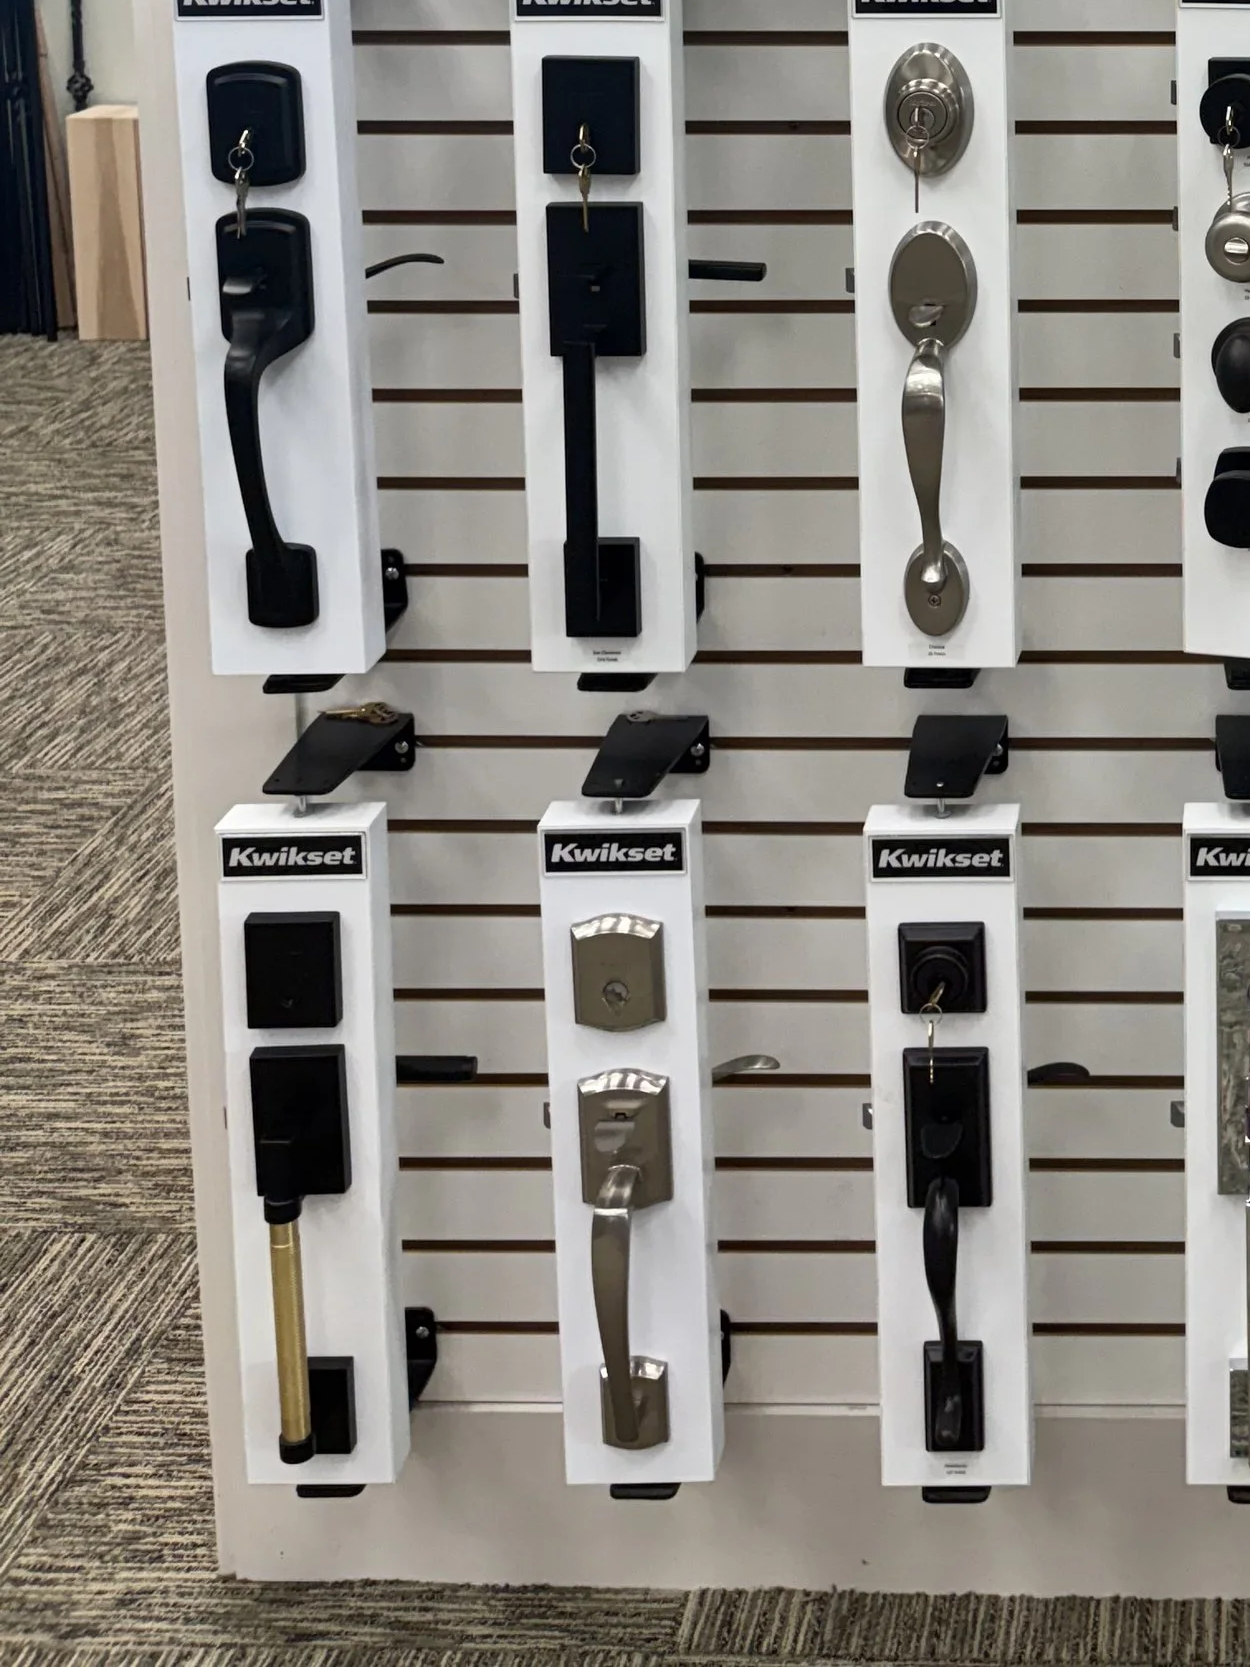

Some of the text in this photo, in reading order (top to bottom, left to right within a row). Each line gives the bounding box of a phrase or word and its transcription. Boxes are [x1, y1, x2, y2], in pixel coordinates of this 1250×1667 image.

[228, 846, 356, 867] Kwikset
[550, 842, 677, 863] Kwikset
[878, 848, 1004, 868] Kwikset
